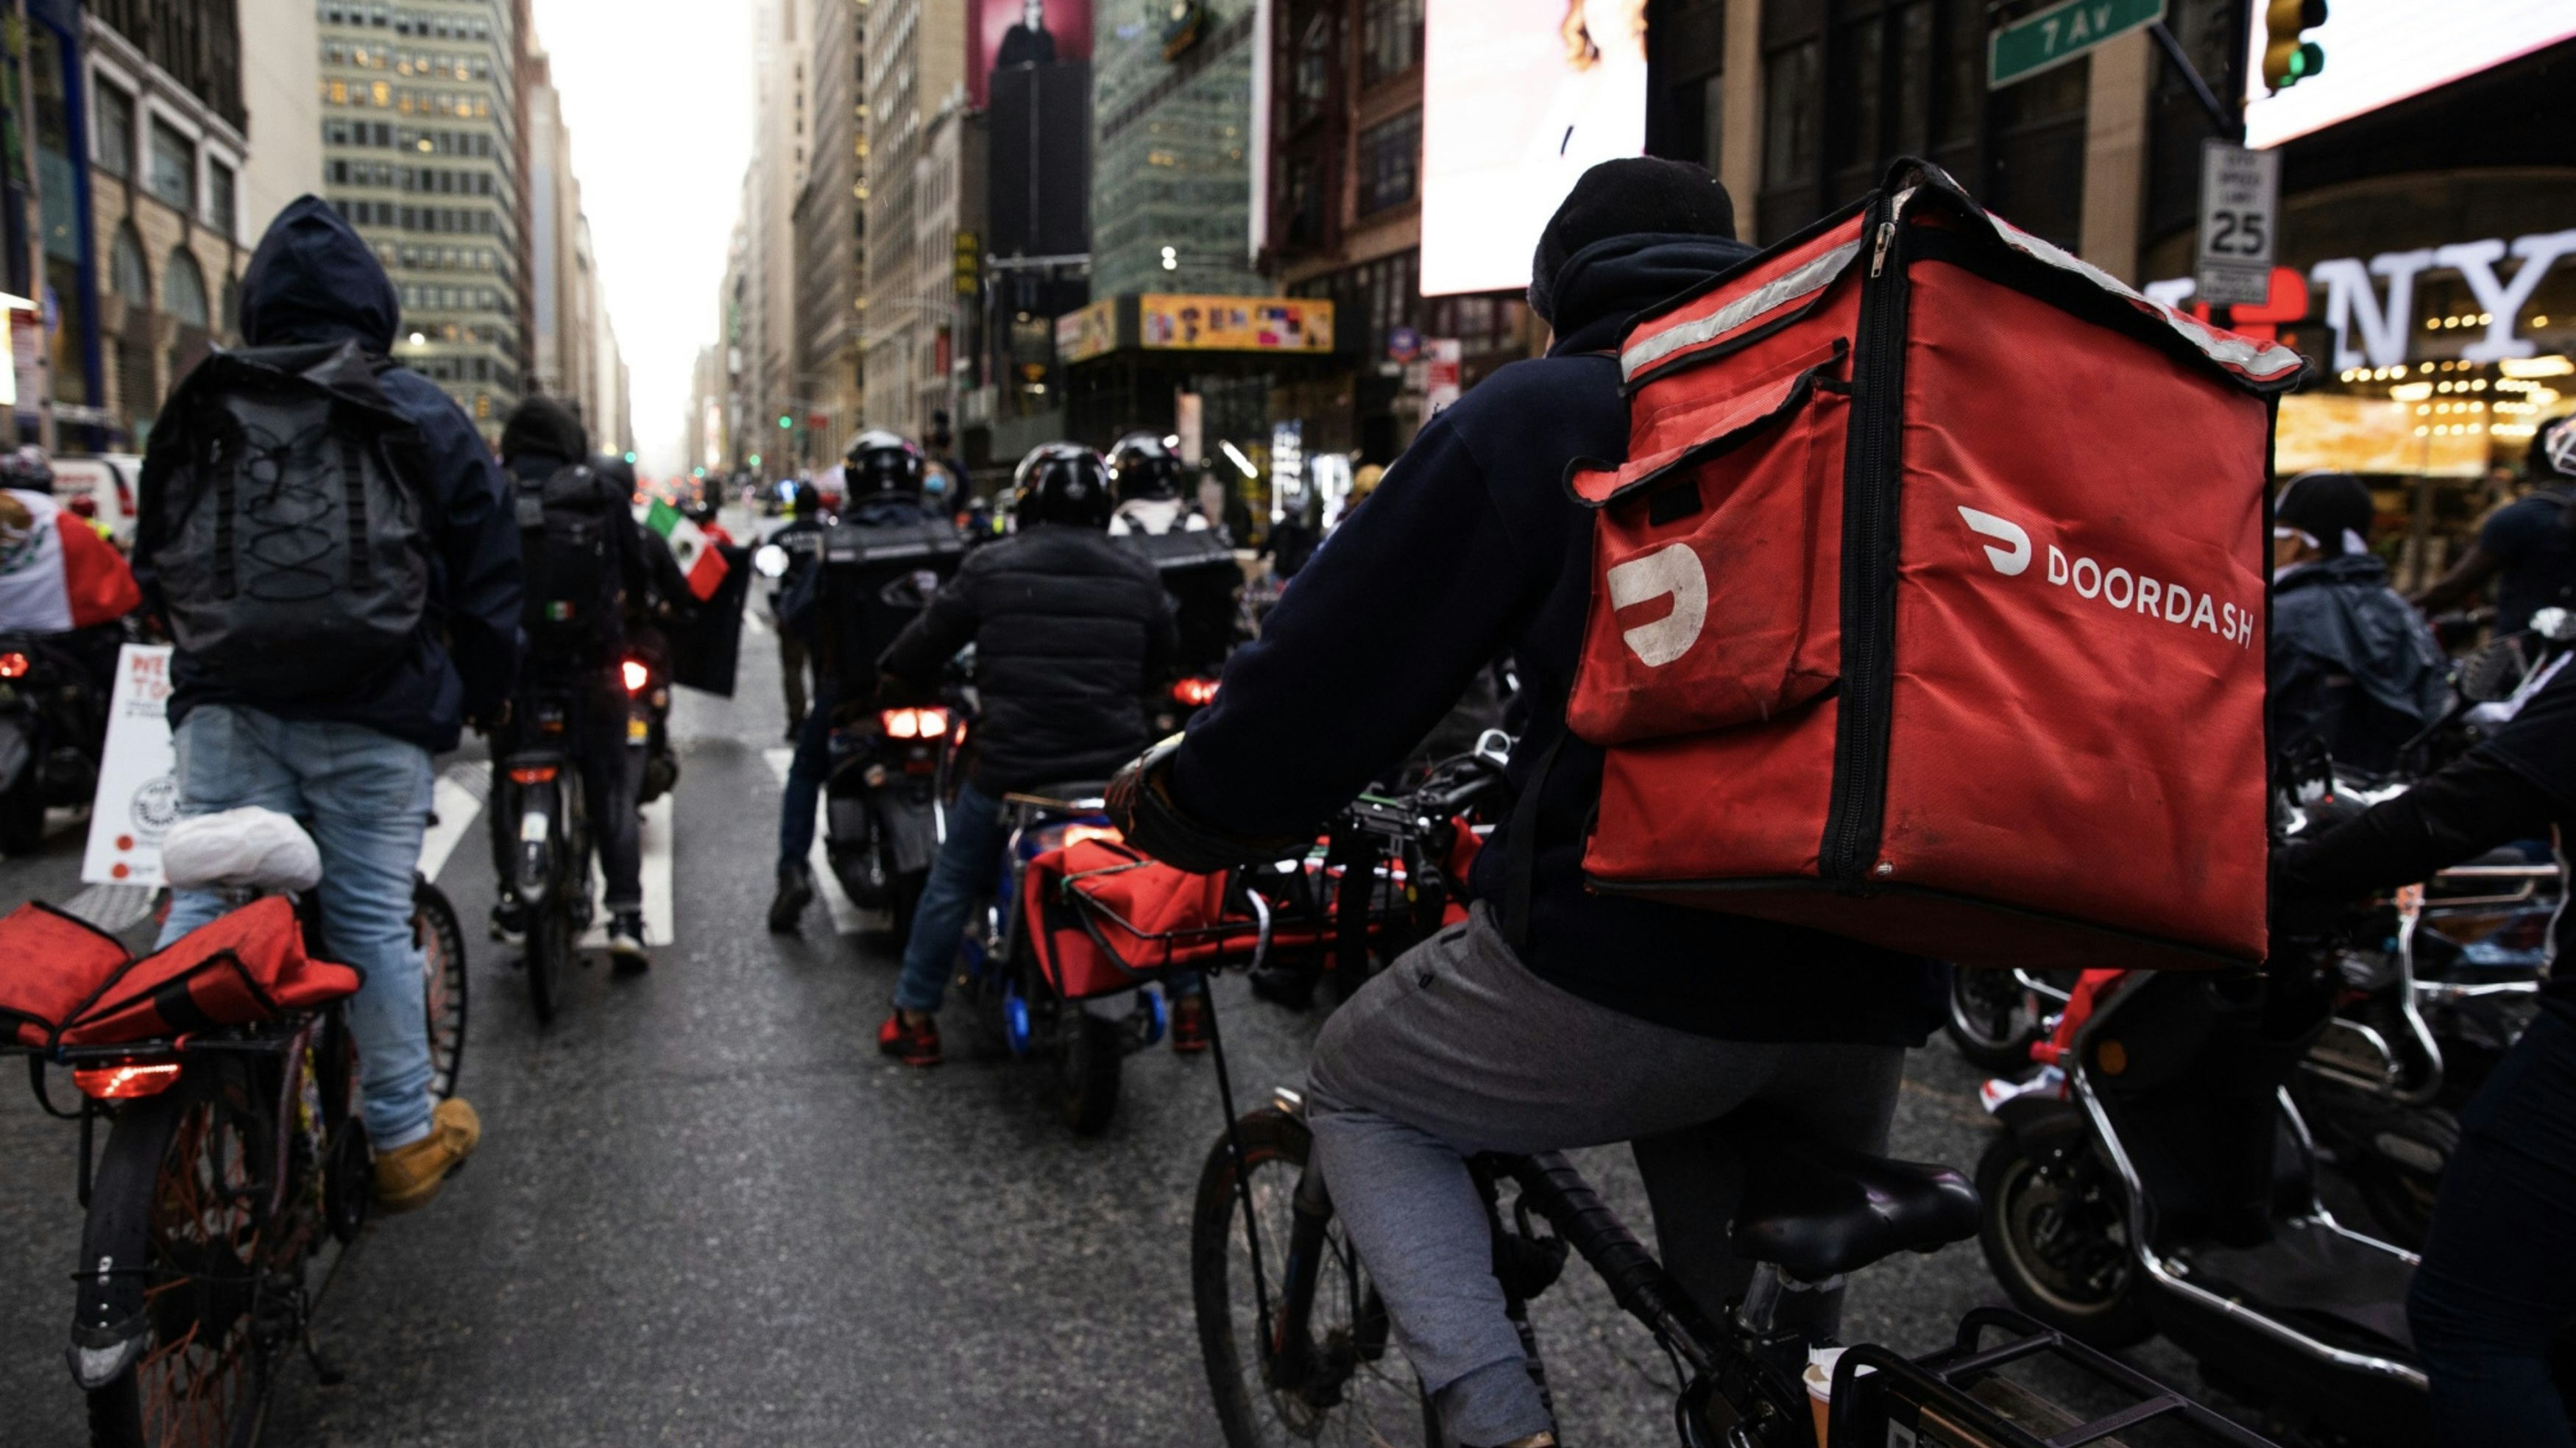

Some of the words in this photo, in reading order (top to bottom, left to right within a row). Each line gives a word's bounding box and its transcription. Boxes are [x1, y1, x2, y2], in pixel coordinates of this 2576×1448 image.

[2040, 18, 2060, 55] 7
[2067, 3, 2113, 45] Av
[2210, 210, 2265, 255] 25
[2310, 228, 2576, 372] NY
[2048, 544, 2253, 650] DOORDASH
